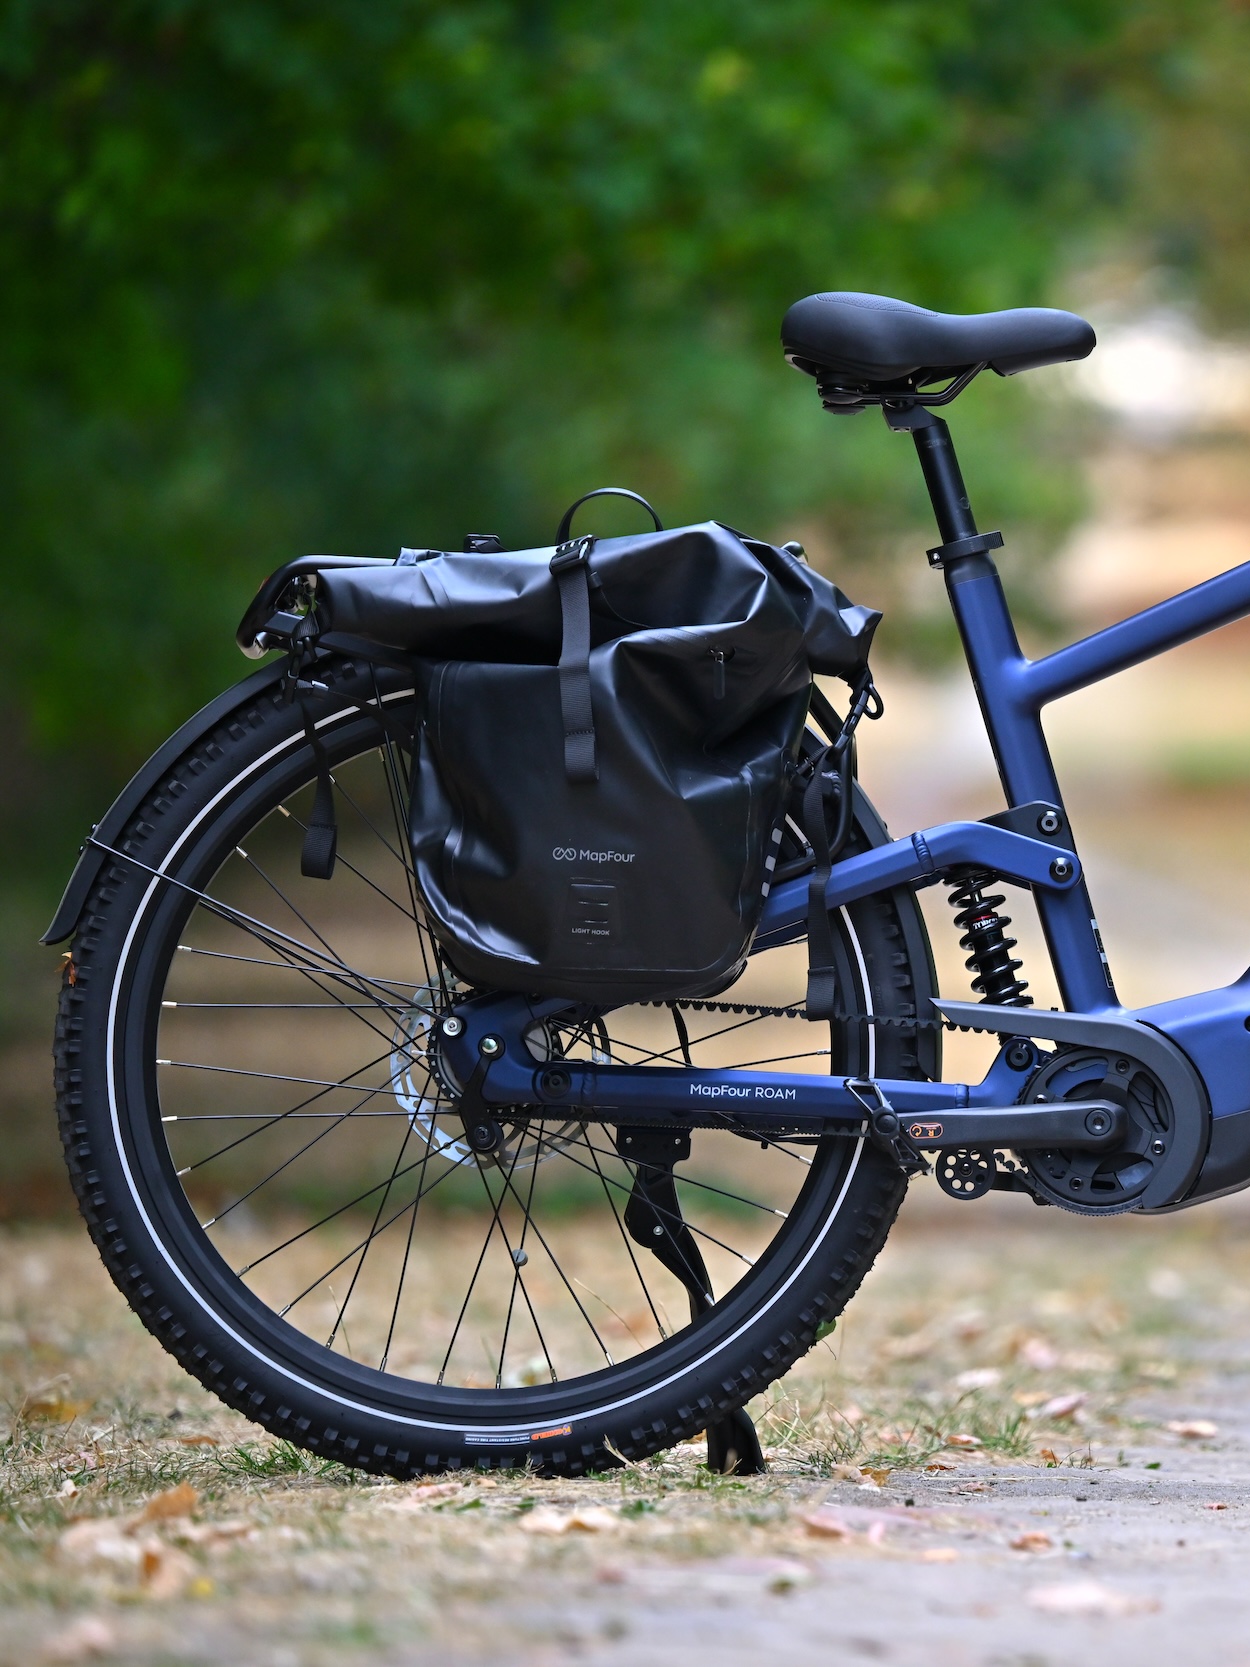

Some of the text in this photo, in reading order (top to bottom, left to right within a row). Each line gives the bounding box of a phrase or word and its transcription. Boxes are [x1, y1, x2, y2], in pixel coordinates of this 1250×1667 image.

[579, 849, 635, 863] MapFour
[689, 1083, 796, 1100] MapFour ROAM
